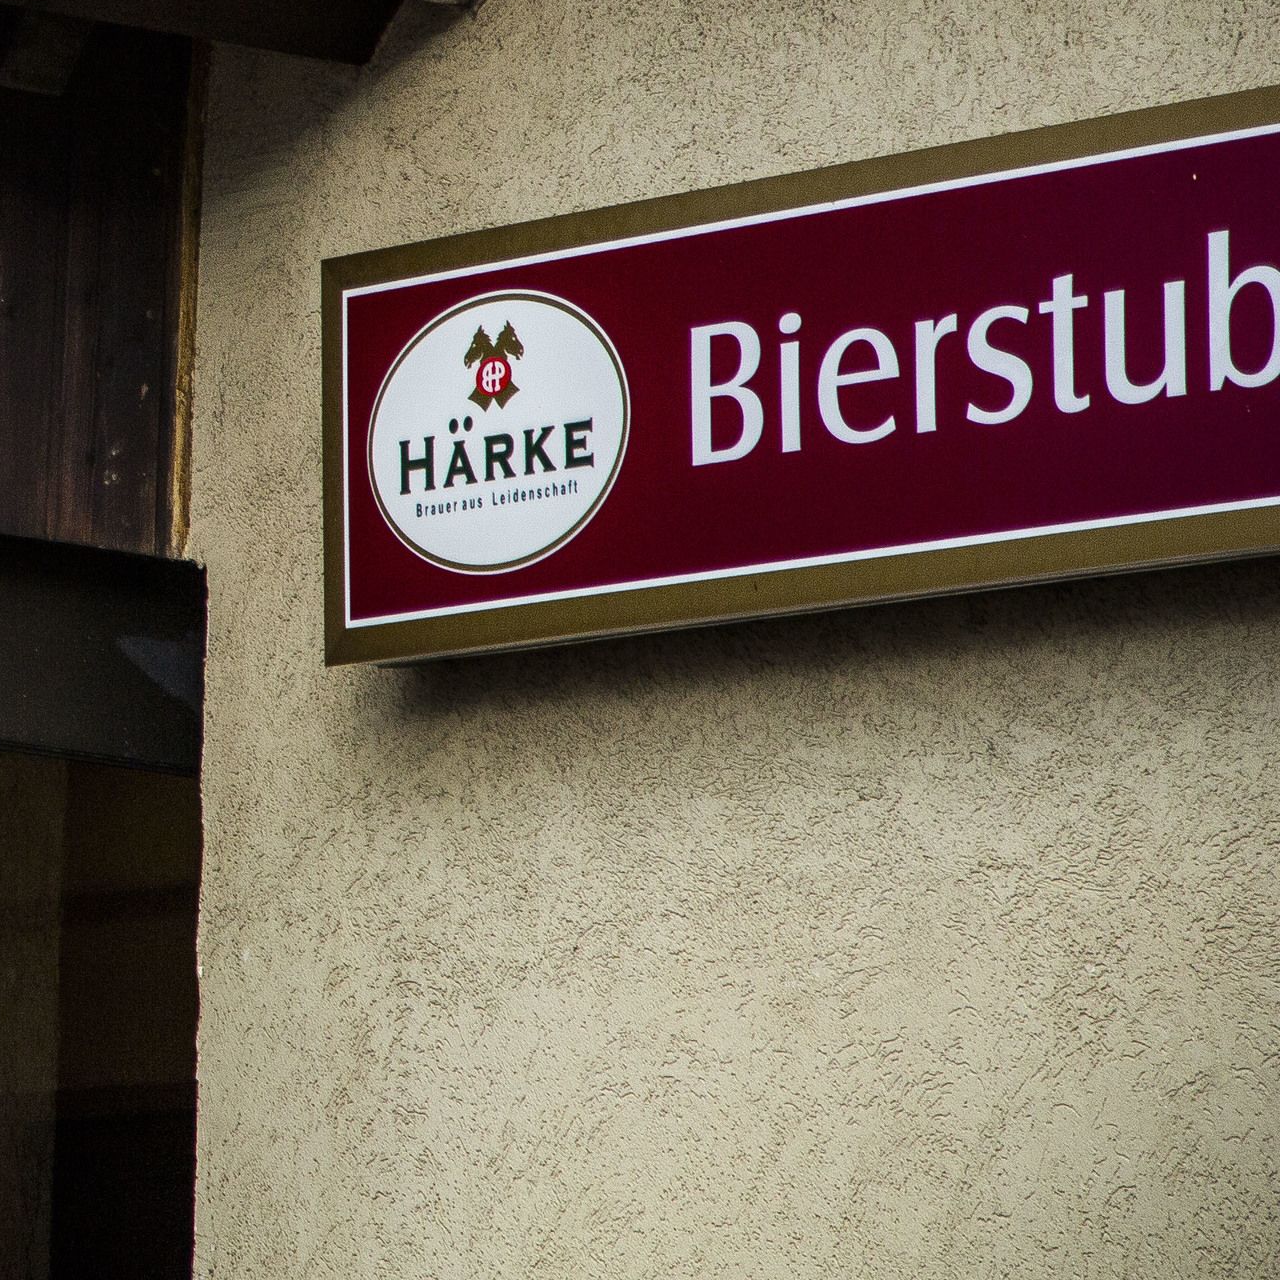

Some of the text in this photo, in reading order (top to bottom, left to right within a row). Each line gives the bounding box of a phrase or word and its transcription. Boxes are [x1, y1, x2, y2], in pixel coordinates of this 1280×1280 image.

[690, 228, 1280, 468] Bierstub
[399, 415, 595, 495] HÄRKE
[492, 479, 579, 506] Leidenschaft
